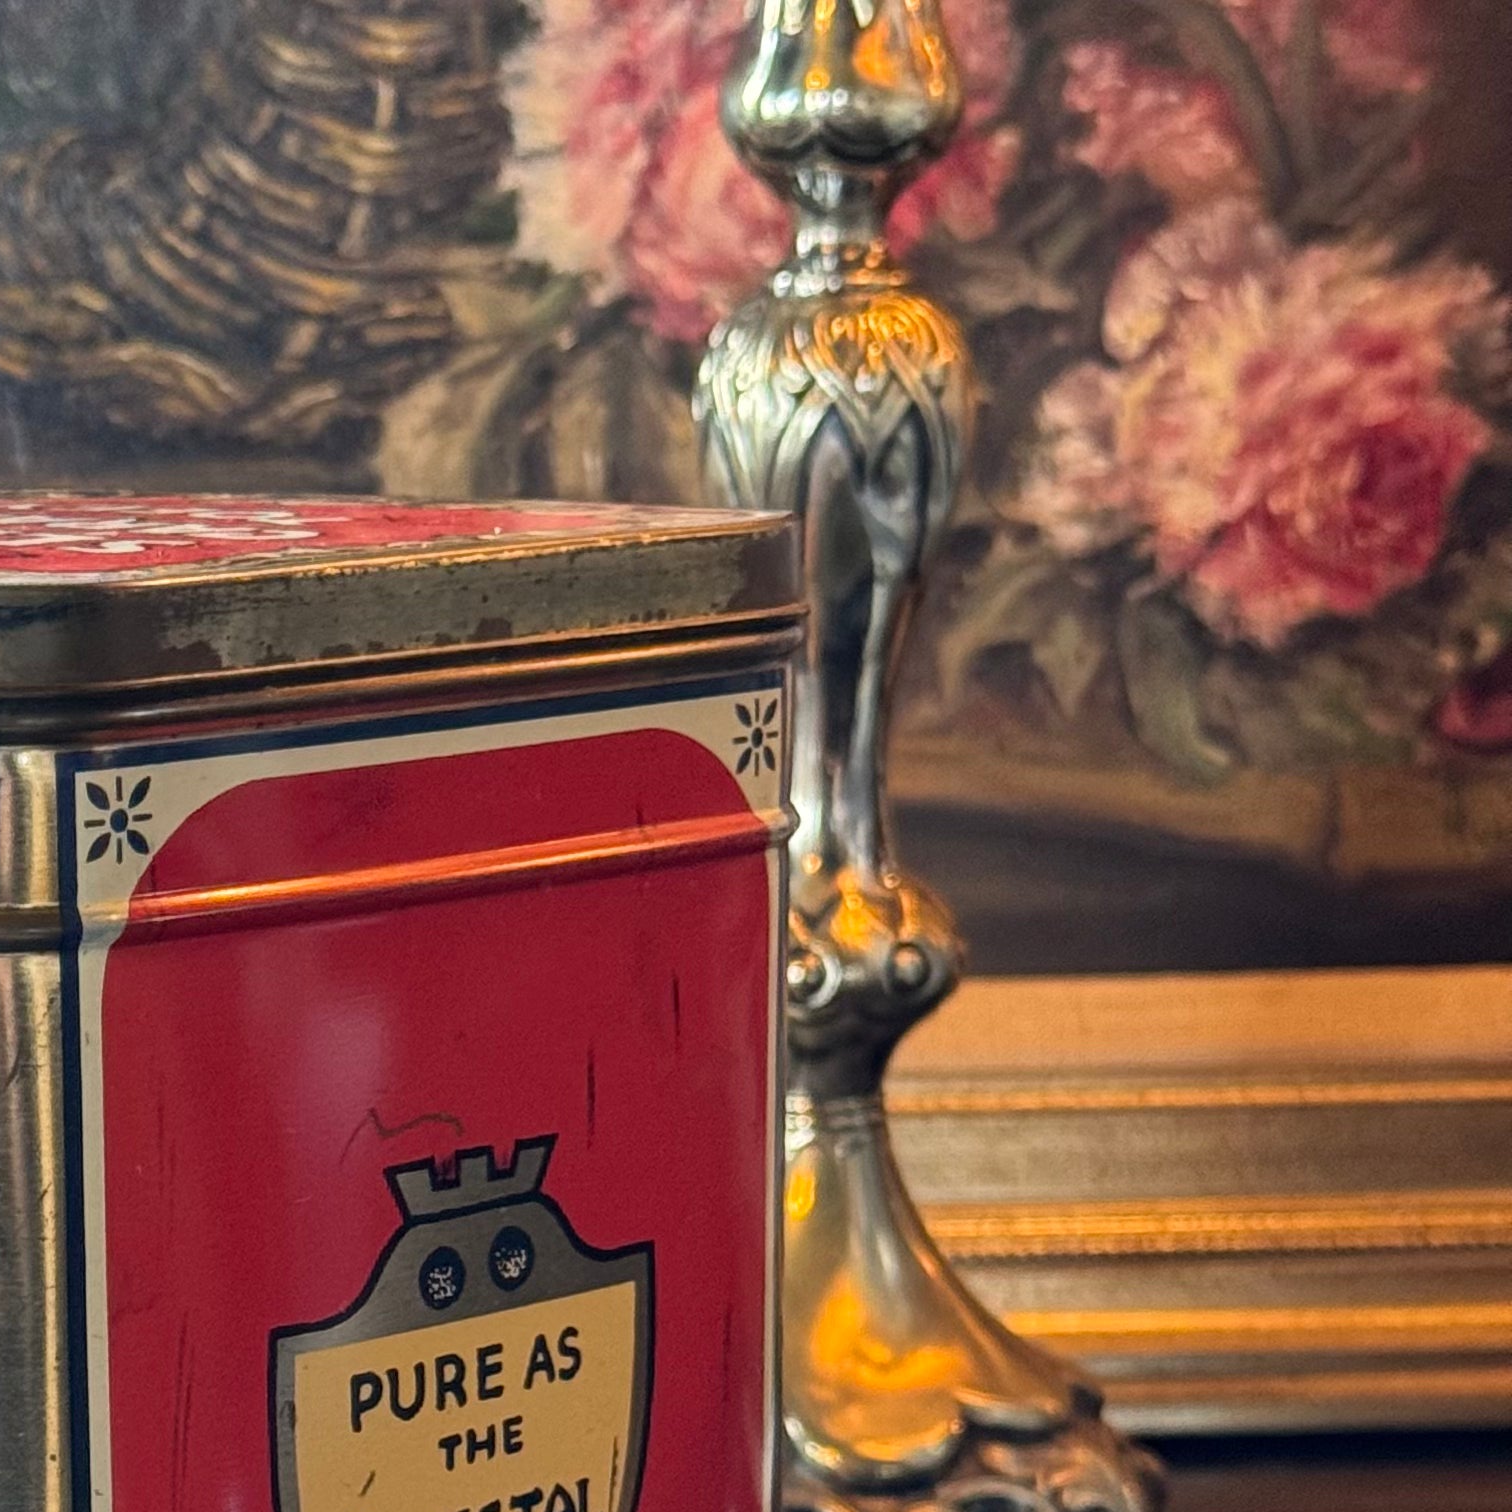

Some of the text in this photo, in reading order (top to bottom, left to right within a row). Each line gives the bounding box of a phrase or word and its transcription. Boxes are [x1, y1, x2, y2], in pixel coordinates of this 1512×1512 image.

[349, 1326, 583, 1433] PURE AS
[438, 1415, 524, 1471] THE
